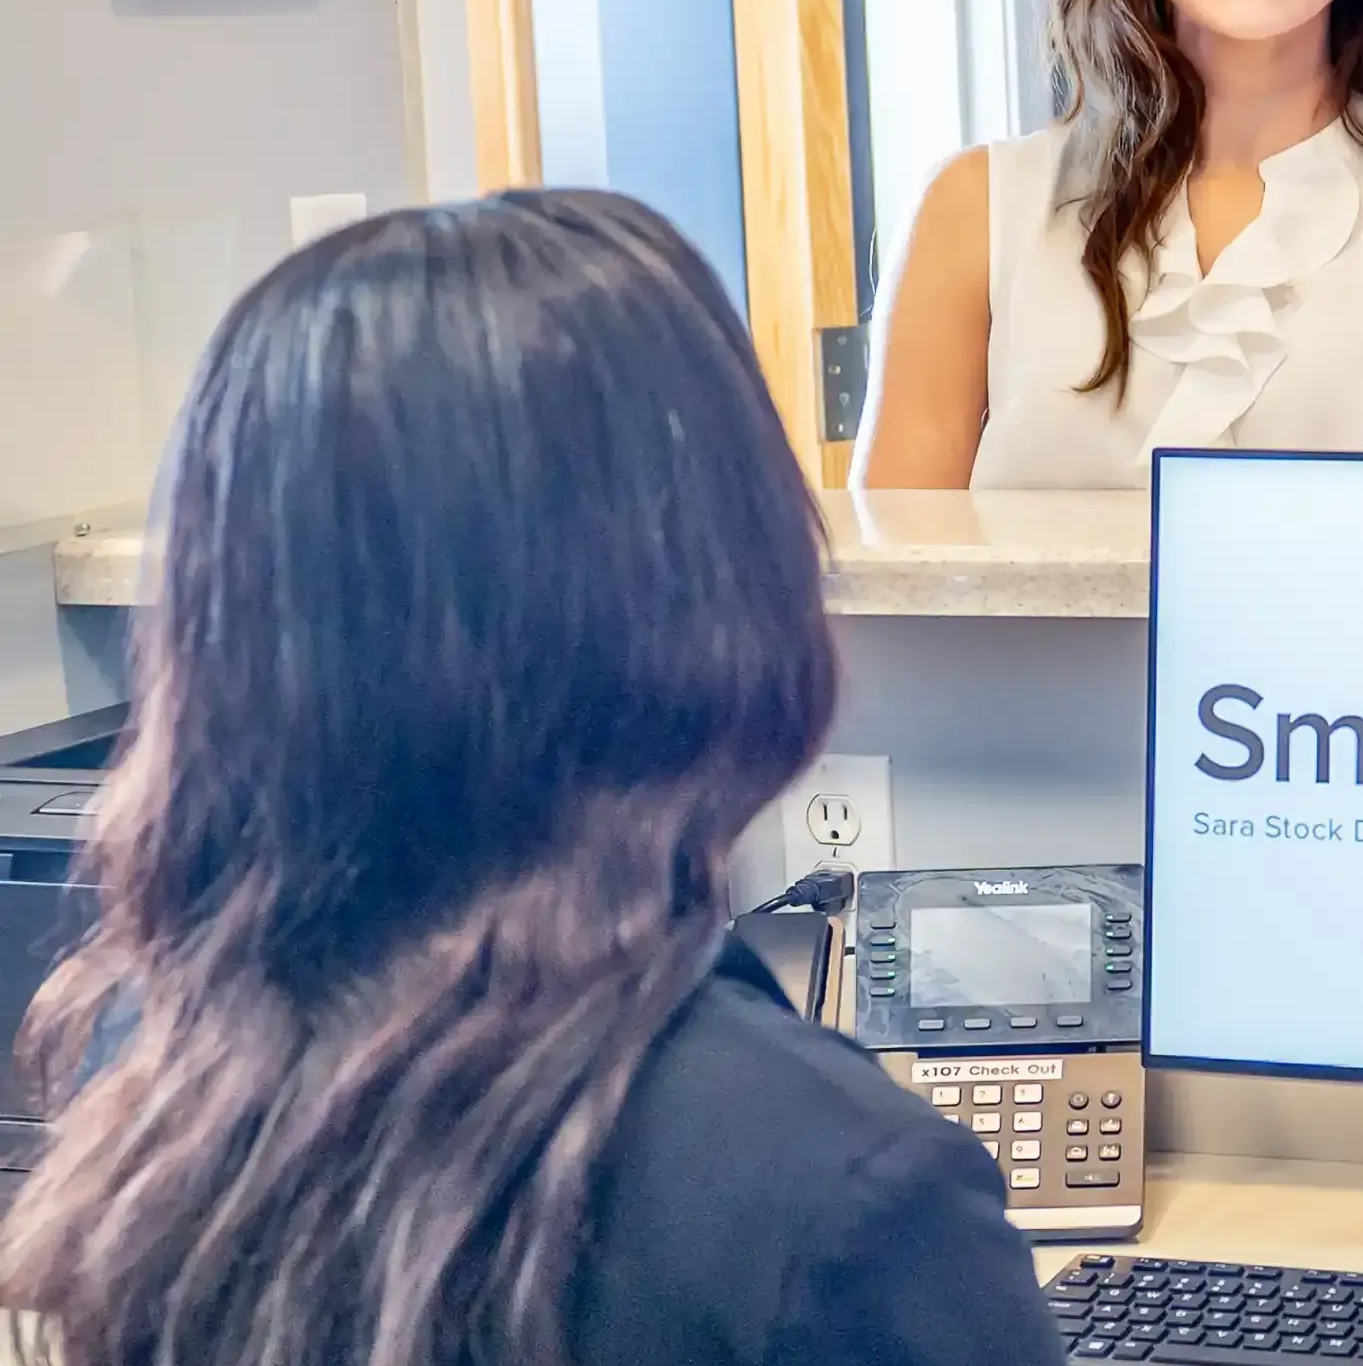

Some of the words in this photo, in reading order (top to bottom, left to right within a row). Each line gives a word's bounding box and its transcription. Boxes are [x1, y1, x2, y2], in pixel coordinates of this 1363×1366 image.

[1193, 811, 1255, 837] Sara
[1265, 815, 1343, 842] Stock
[973, 880, 1029, 895] Yealink
[921, 1066, 962, 1078] x107
[969, 1065, 1020, 1076] Check
[1028, 1063, 1057, 1075] Out
